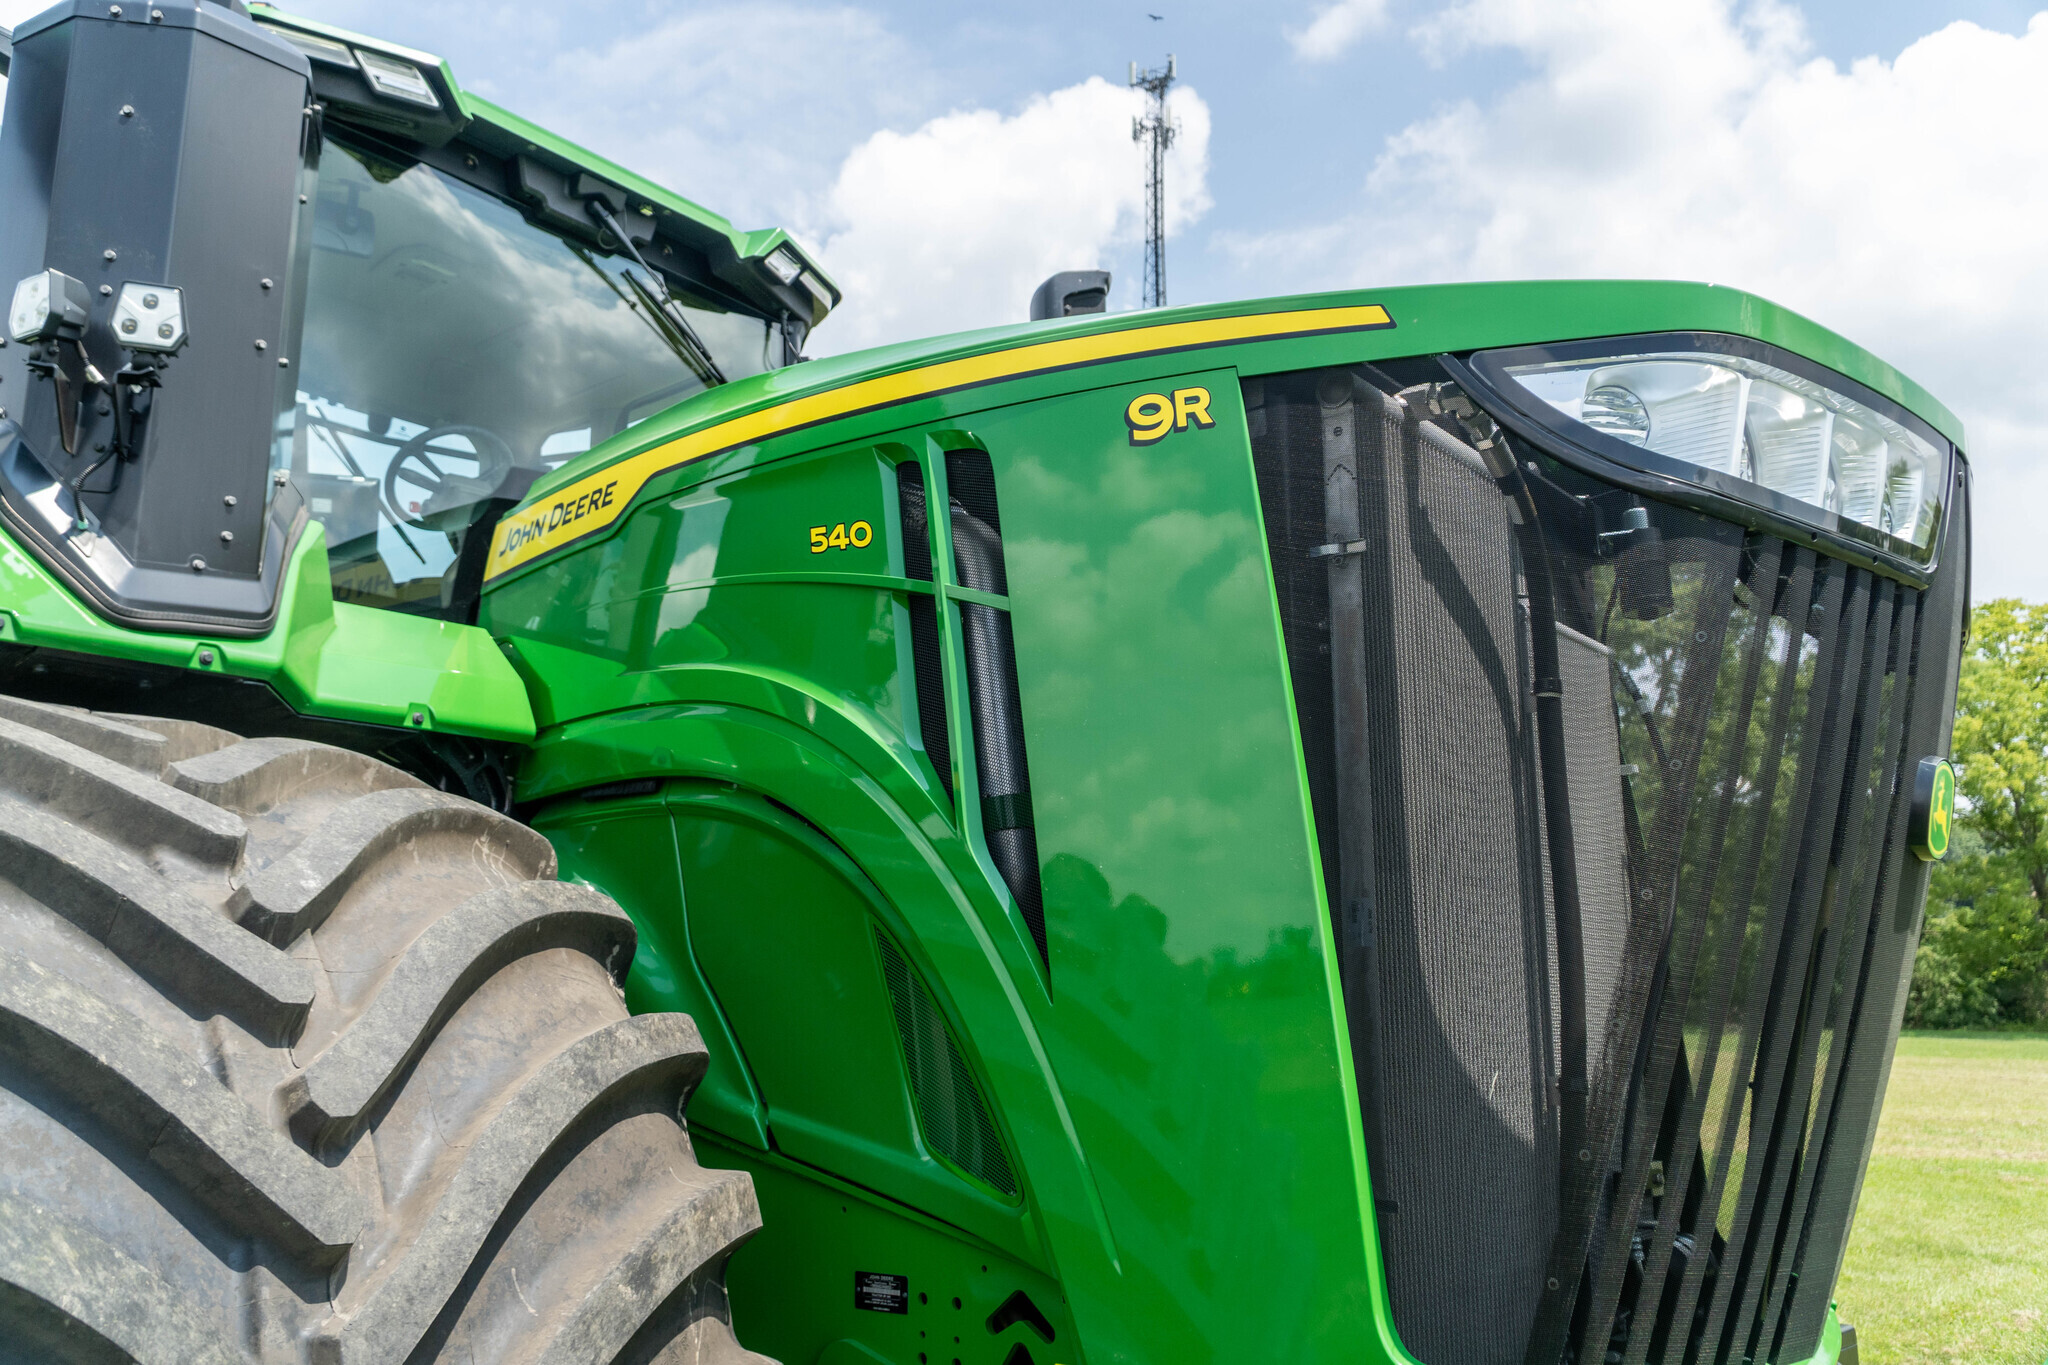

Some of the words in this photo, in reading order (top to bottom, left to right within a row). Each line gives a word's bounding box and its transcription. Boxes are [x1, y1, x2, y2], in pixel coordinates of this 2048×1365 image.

[1124, 386, 1216, 446] 9R
[498, 514, 547, 558] JOHN
[547, 480, 618, 533] DEERE
[809, 520, 873, 554] 540
